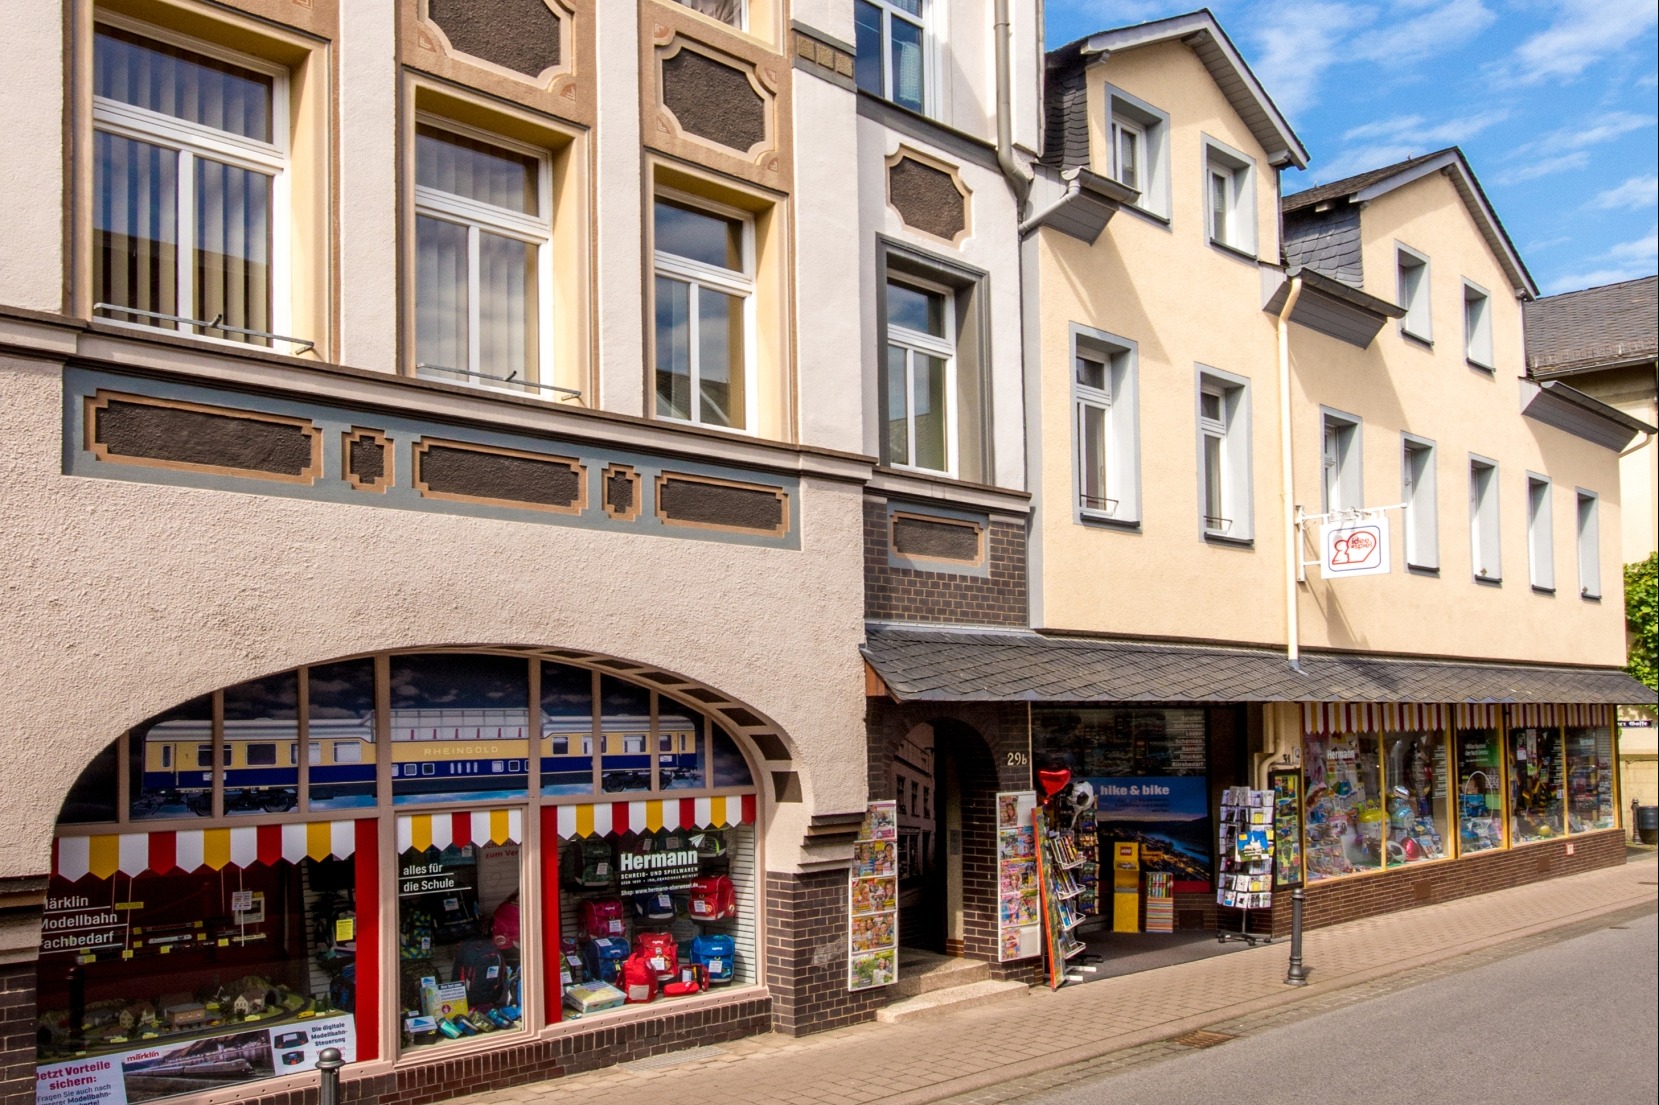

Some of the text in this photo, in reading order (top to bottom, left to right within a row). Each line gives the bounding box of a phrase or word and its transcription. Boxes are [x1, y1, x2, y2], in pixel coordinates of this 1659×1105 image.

[424, 746, 499, 756] RHEINGOLD
[1326, 749, 1355, 759] Hermann
[1007, 752, 1028, 766] 29b
[1100, 784, 1170, 796] hike & bike
[485, 851, 503, 859] zum
[620, 850, 698, 871] Hermann
[403, 862, 443, 876] alles für
[621, 872, 648, 880] SCHREIB-
[663, 867, 698, 875] SPIELWAREN
[403, 877, 455, 892] die Schule
[41, 930, 114, 949] achbedarf
[322, 1022, 345, 1031] digitale
[310, 1029, 348, 1040] Modellbahn-
[314, 1037, 346, 1047] Steuerung
[126, 1050, 160, 1062] märklin
[64, 1060, 111, 1076] Vorteile
[49, 1075, 97, 1091] sichern:
[37, 1083, 112, 1102] Fragen Sie auch nach
[67, 1092, 112, 1104] Modellbahn-
